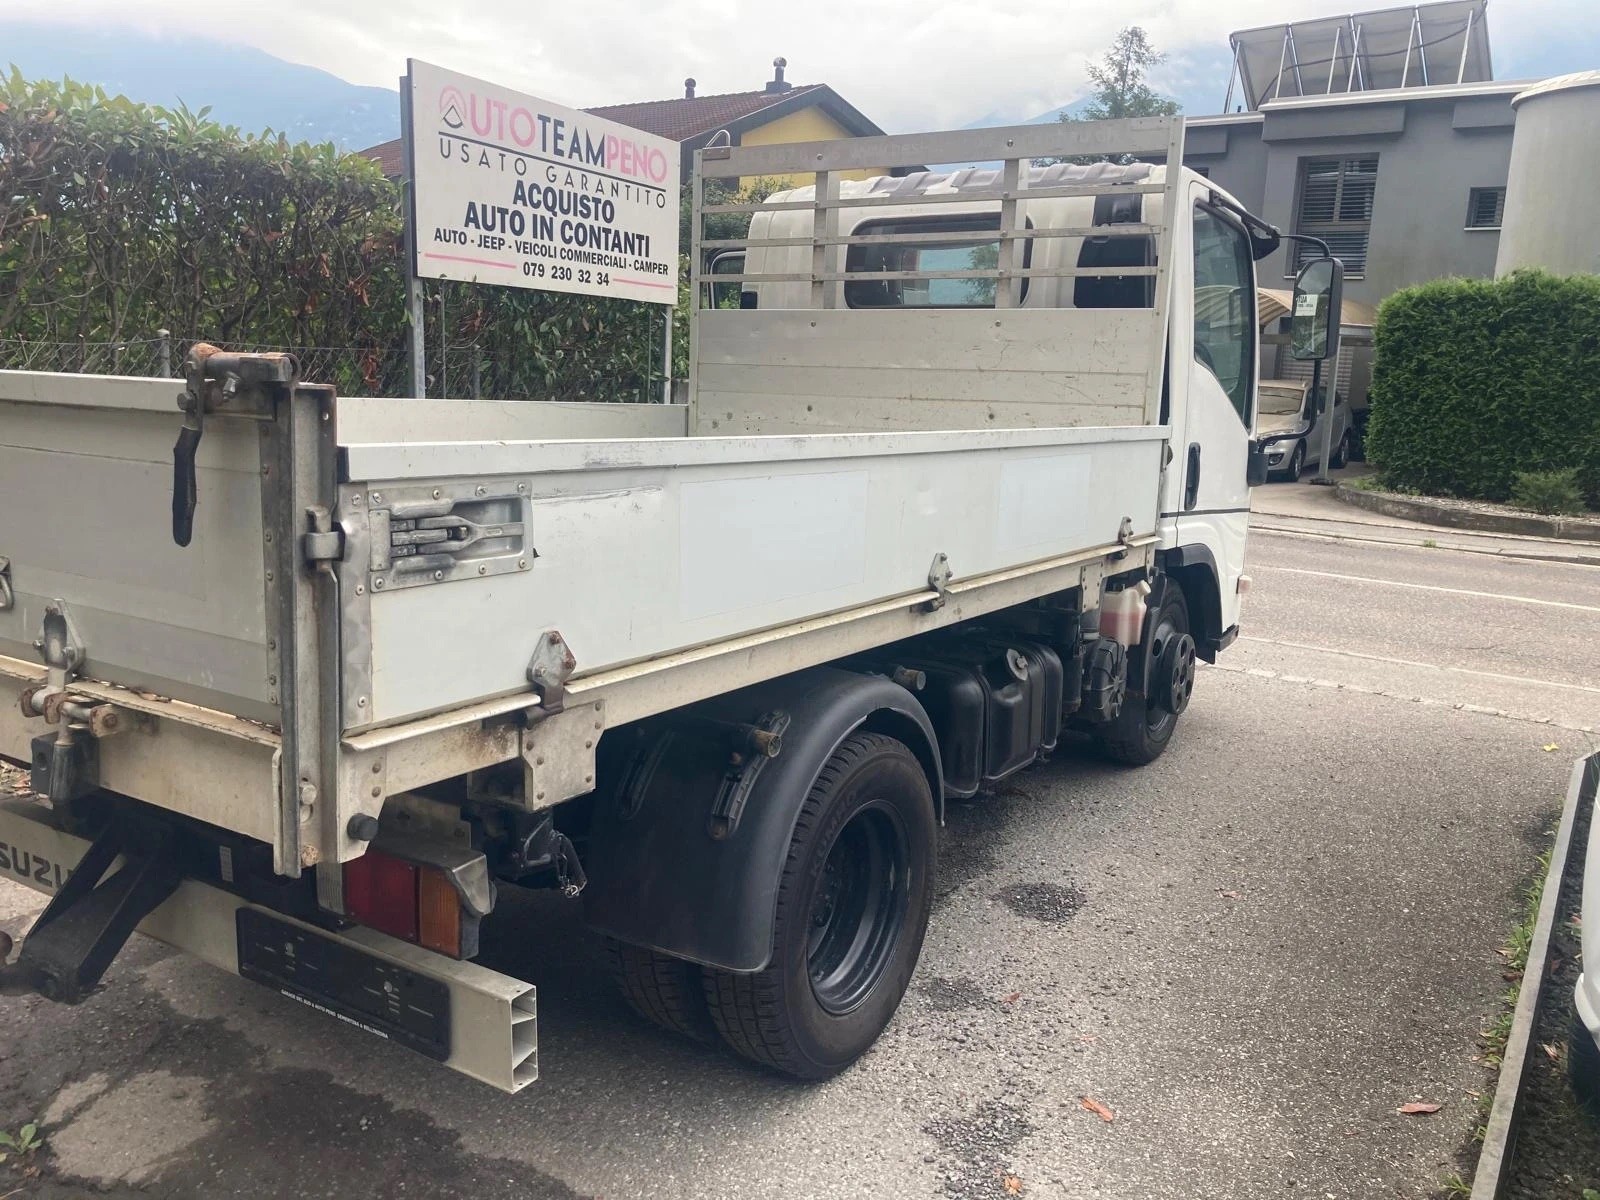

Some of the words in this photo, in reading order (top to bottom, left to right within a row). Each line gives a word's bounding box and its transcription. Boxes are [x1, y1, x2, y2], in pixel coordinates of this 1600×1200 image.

[439, 137, 527, 176] USATO
[545, 165, 666, 209] GARANTITO
[512, 179, 615, 224] ACQUISTO
[434, 227, 467, 245] AUTO
[477, 233, 505, 251] JEEP
[514, 239, 557, 259] VEICOLI
[560, 247, 627, 270] COMMERCIALI
[633, 259, 669, 276] CAMPER
[464, 201, 525, 237] AUTO
[532, 213, 554, 242] IN
[560, 220, 650, 258] CONTANTI
[523, 261, 545, 278] 079
[551, 265, 572, 282] 230
[577, 269, 591, 285] 32
[596, 272, 610, 287] 34
